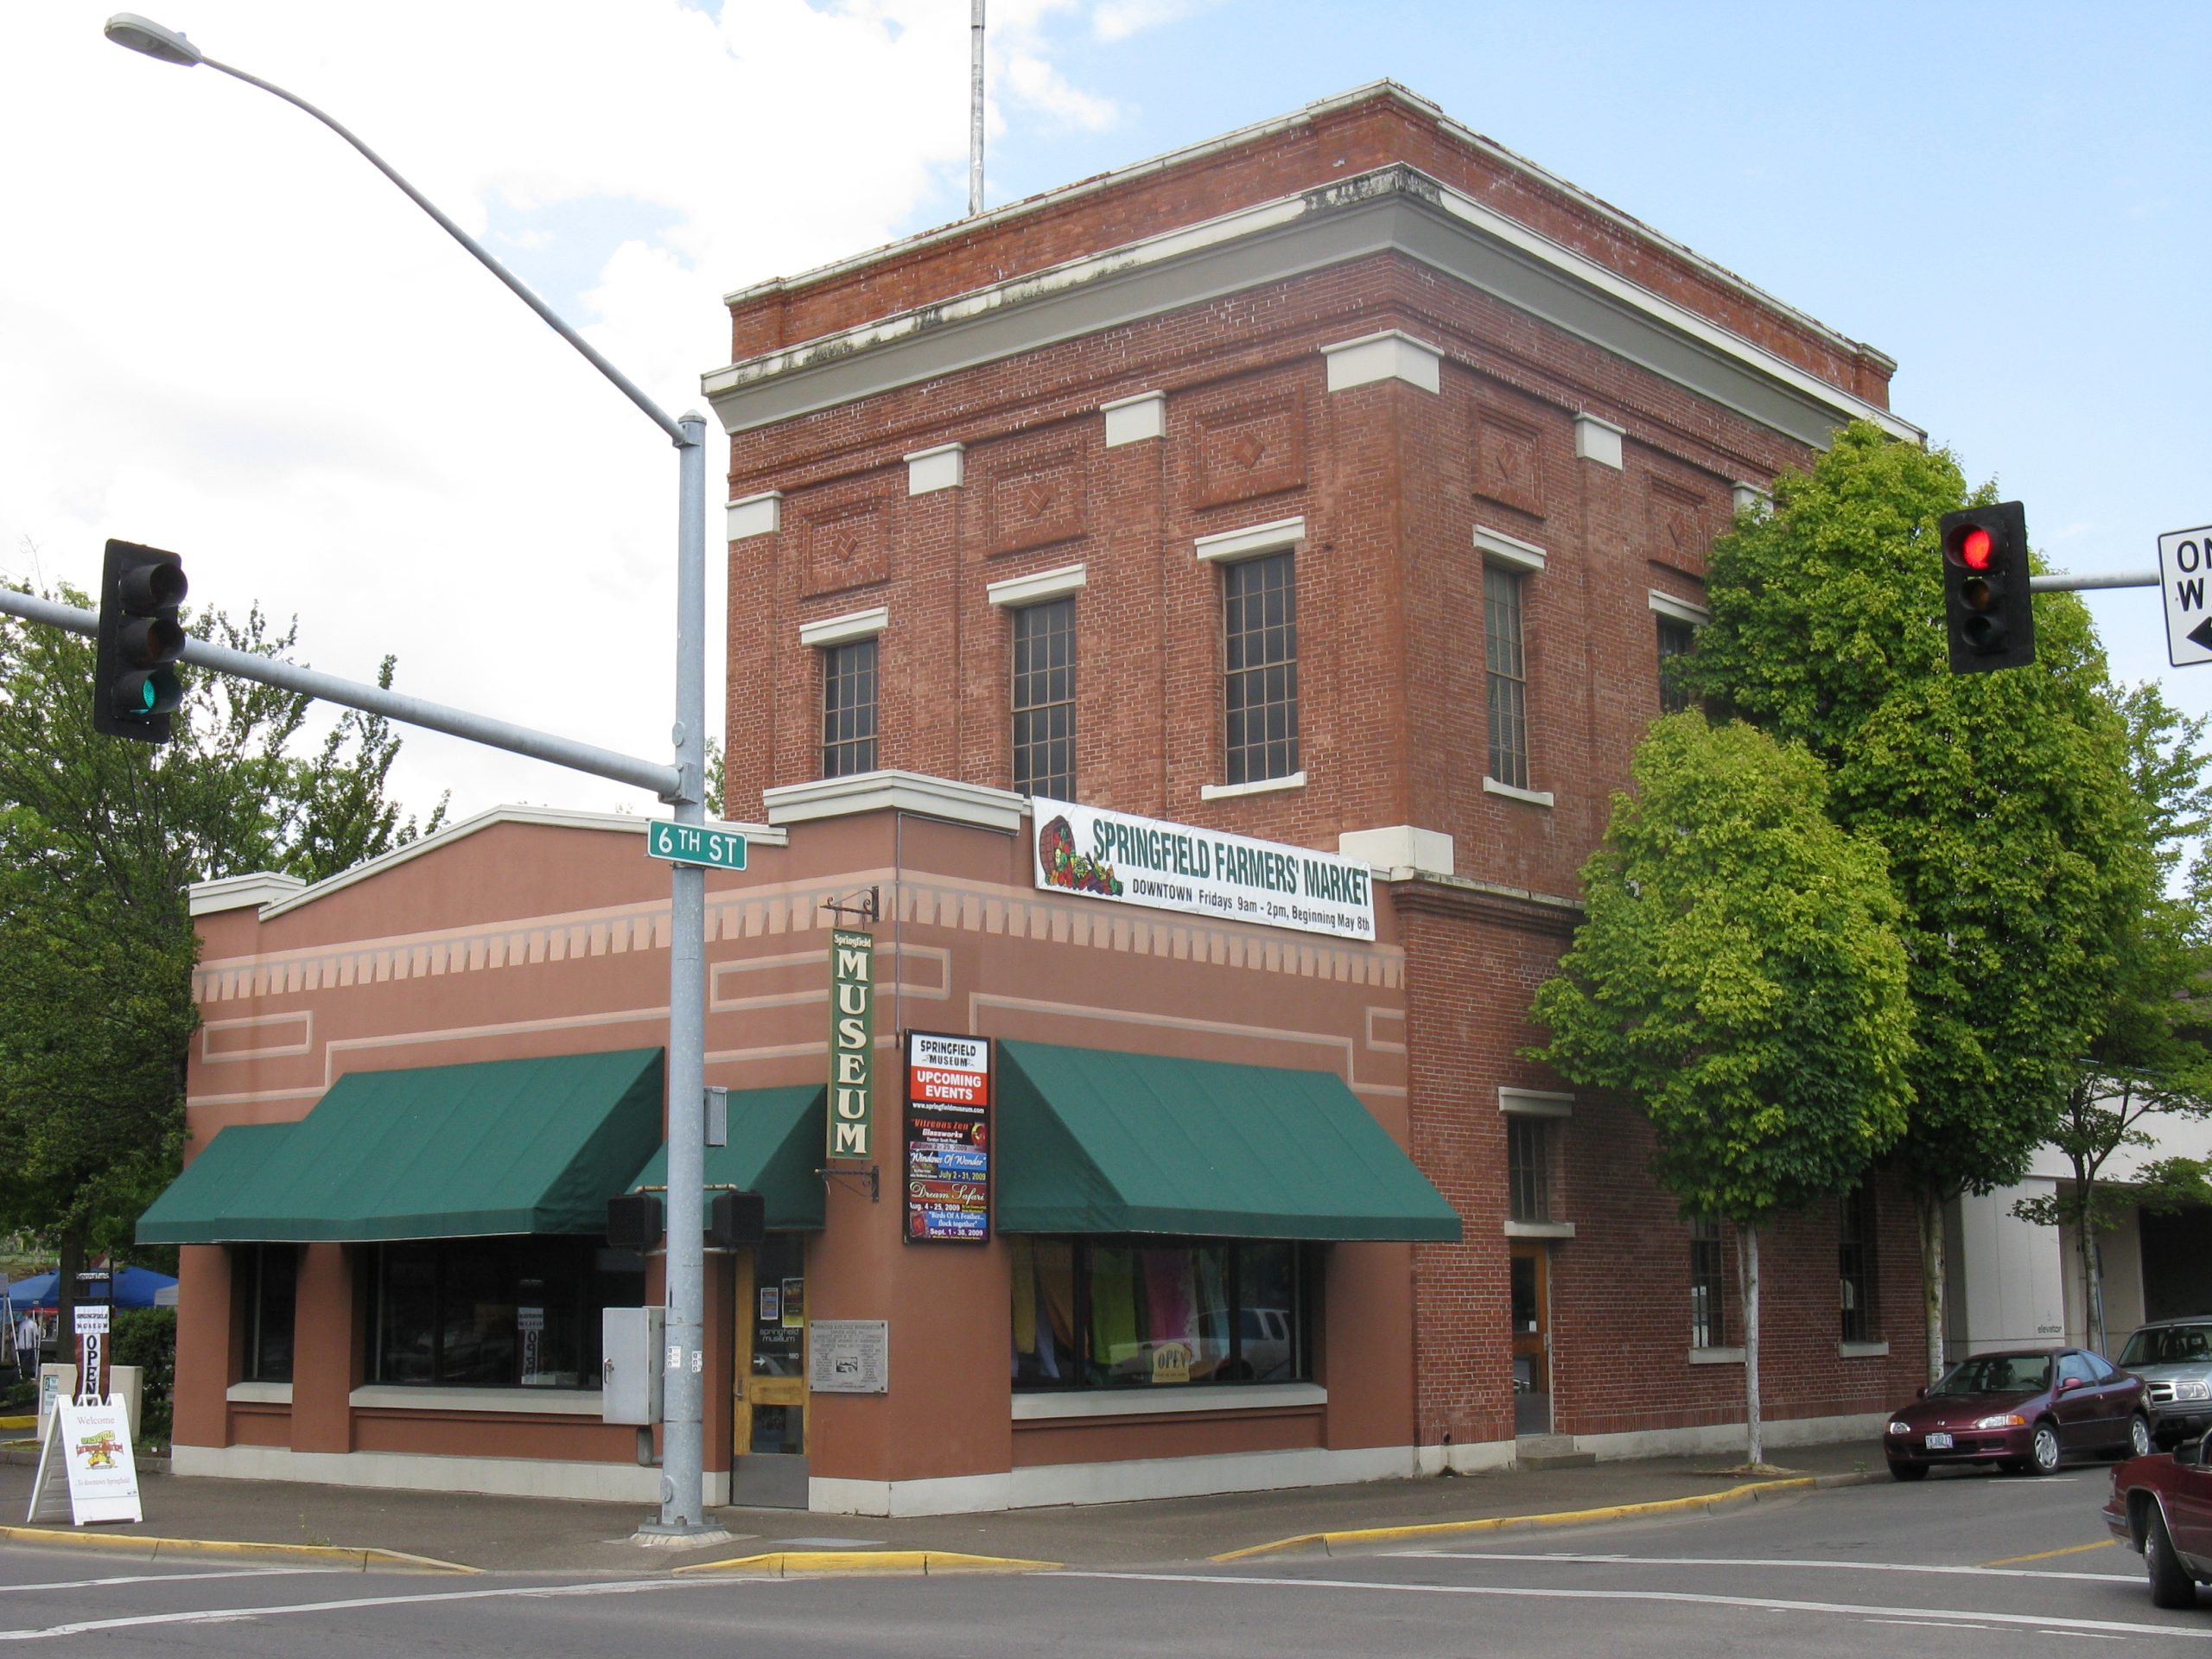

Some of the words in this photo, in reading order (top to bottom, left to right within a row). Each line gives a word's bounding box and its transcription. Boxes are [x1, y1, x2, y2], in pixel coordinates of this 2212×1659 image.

[658, 827, 700, 854] 6TH
[709, 835, 737, 864] ST
[1093, 818, 1211, 879] SPRINGFIELD
[1214, 842, 1300, 895] FARMERS'
[1303, 859, 1369, 906] MARKET
[1133, 878, 1192, 902] DOWNTOWN
[1198, 889, 1233, 909] Fridays
[1237, 896, 1258, 912] 9am
[1267, 901, 1290, 921] 2pm,
[1292, 905, 1336, 929] Beginning
[1338, 912, 1355, 931] May
[1357, 916, 1370, 931] 8th
[834, 933, 872, 949] Springfield
[835, 950, 868, 1154] MUSEUM
[920, 1039, 976, 1057] SPRINGFIELD
[929, 1054, 968, 1067] MUSEUM
[917, 1070, 982, 1088] UPCOMING
[925, 1084, 973, 1100] EVENTS
[922, 1128, 963, 1138] Glassworks
[944, 1154, 955, 1166] Of
[938, 1170, 952, 1180] July
[910, 1181, 950, 1198] Dream
[951, 1183, 985, 1205] Safari
[760, 1327, 799, 1337] springfield
[2037, 1324, 2063, 1333] elevator
[86, 1335, 98, 1394] OPEN
[77, 1416, 116, 1425] Welcome
